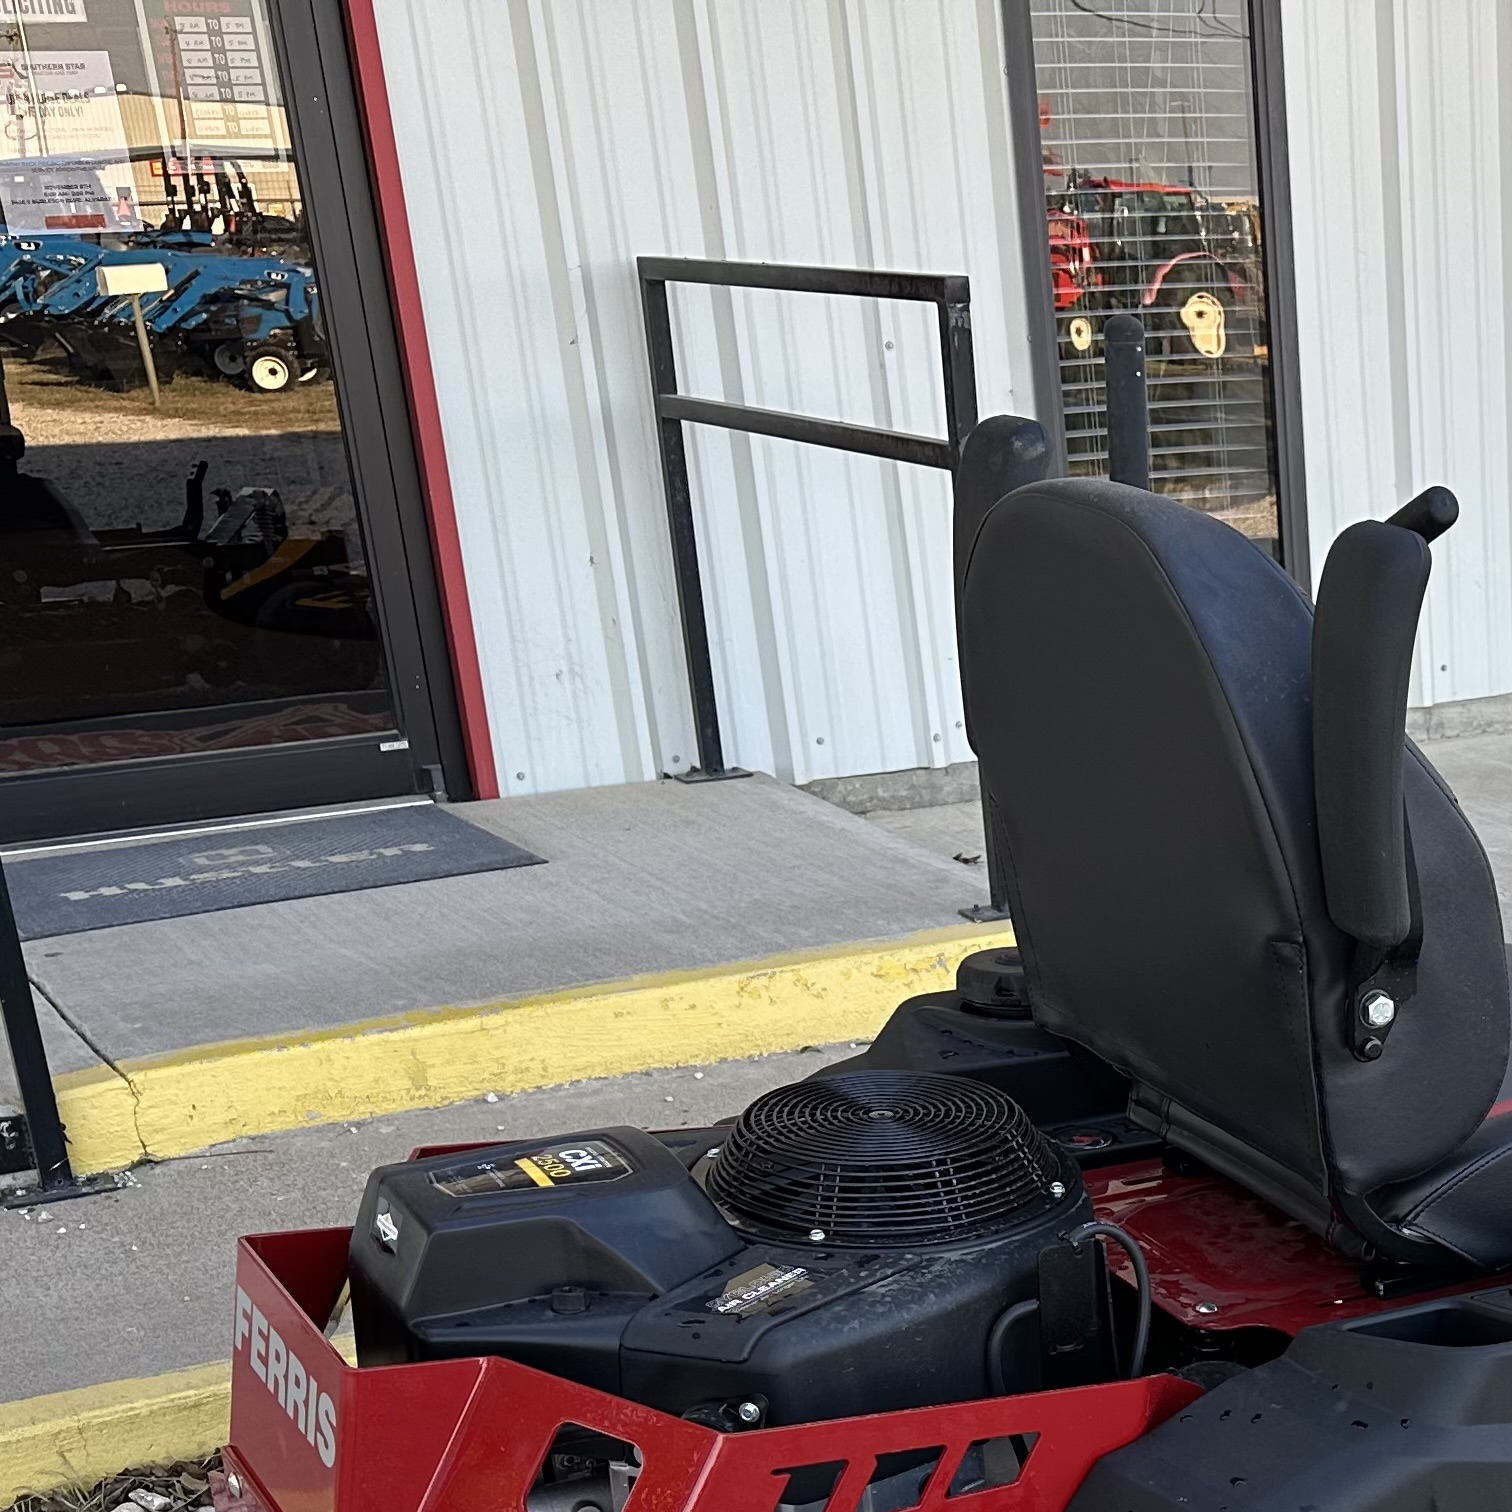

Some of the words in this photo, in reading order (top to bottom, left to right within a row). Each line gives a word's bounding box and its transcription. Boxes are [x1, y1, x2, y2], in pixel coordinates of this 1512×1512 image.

[207, 19, 219, 30] TO
[210, 36, 222, 47] TO
[213, 53, 225, 65] TO
[216, 71, 228, 81] TO
[219, 88, 231, 98] TO
[223, 104, 235, 115] TO
[227, 122, 238, 133] TO
[59, 843, 435, 901] HUSTLER
[558, 1149, 603, 1171] CXi
[530, 1154, 572, 1178] 2500
[718, 1299, 744, 1313] AIR
[742, 1267, 807, 1299] CLEANER
[234, 1285, 337, 1469] FERRIS
